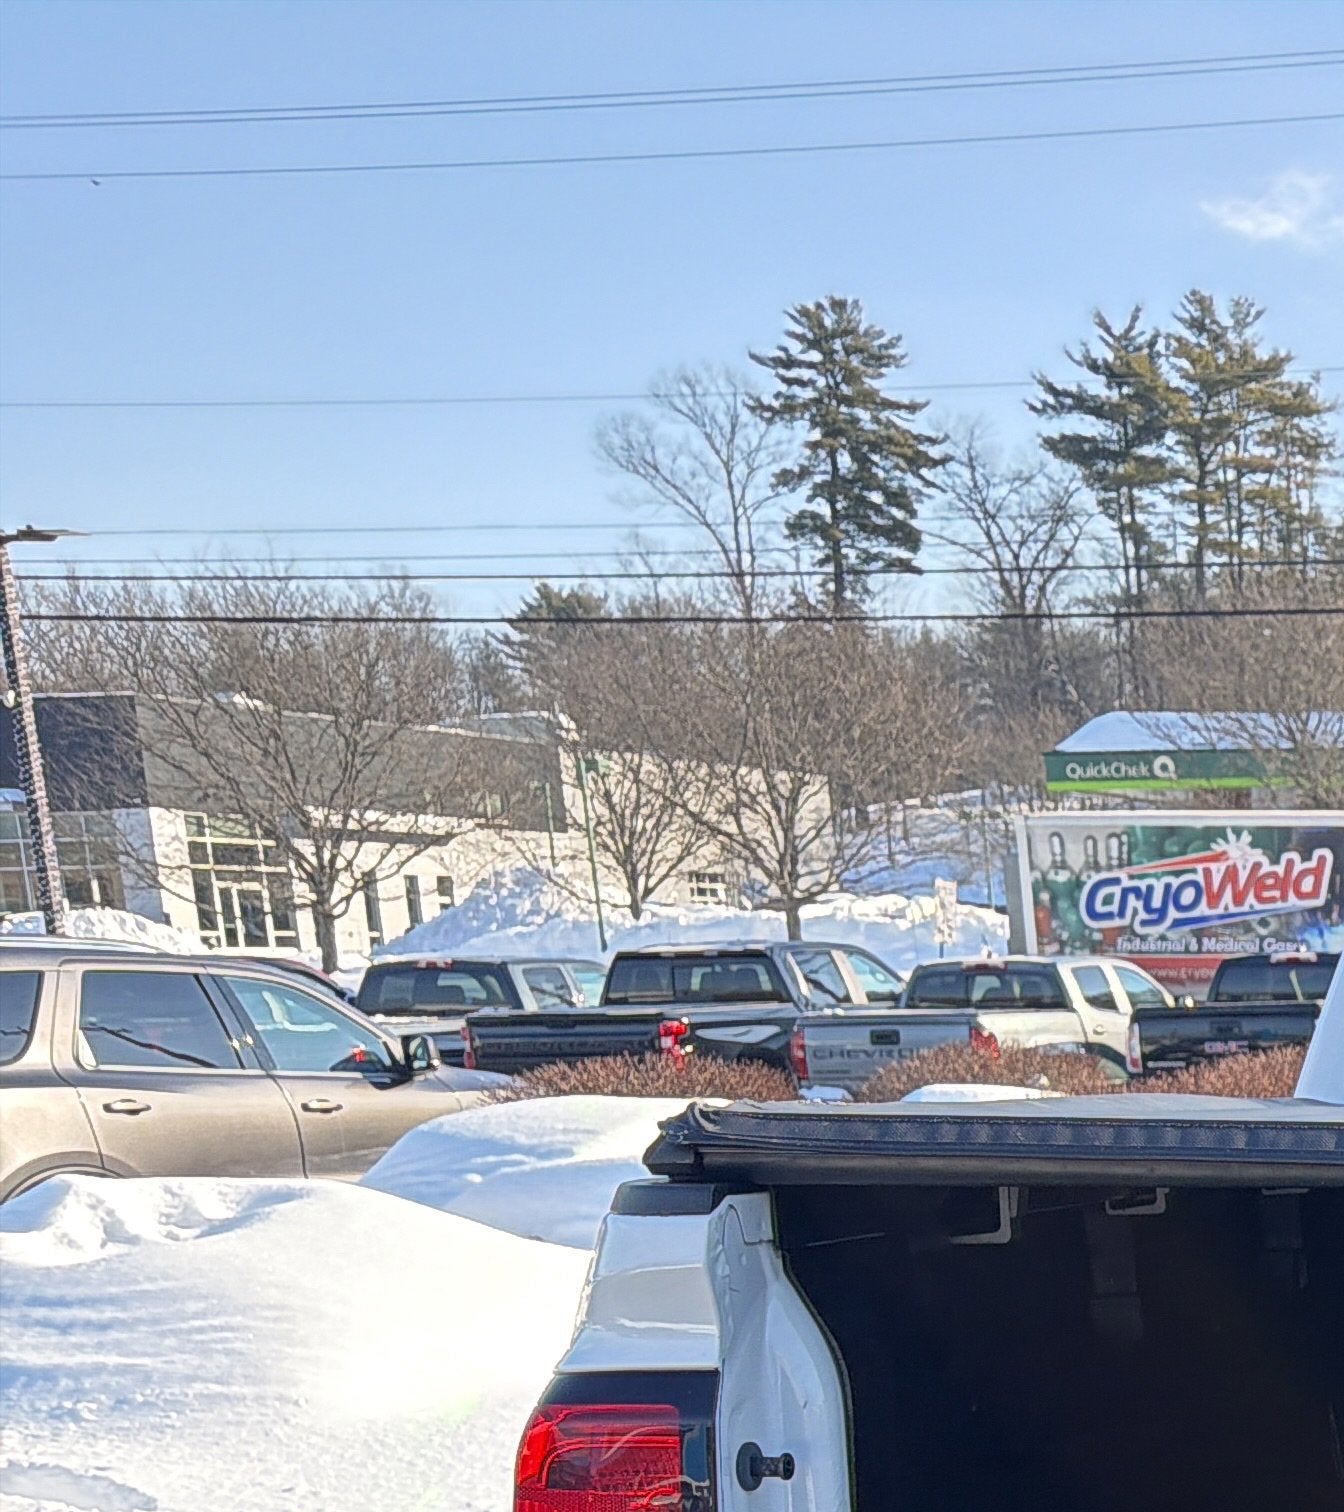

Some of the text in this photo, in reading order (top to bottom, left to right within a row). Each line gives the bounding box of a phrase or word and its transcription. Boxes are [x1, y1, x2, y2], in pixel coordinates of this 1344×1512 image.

[1065, 761, 1150, 779] QuickChek
[1082, 852, 1330, 930] CryoWeld
[1116, 936, 1306, 953] Industrial & Medical Gas
